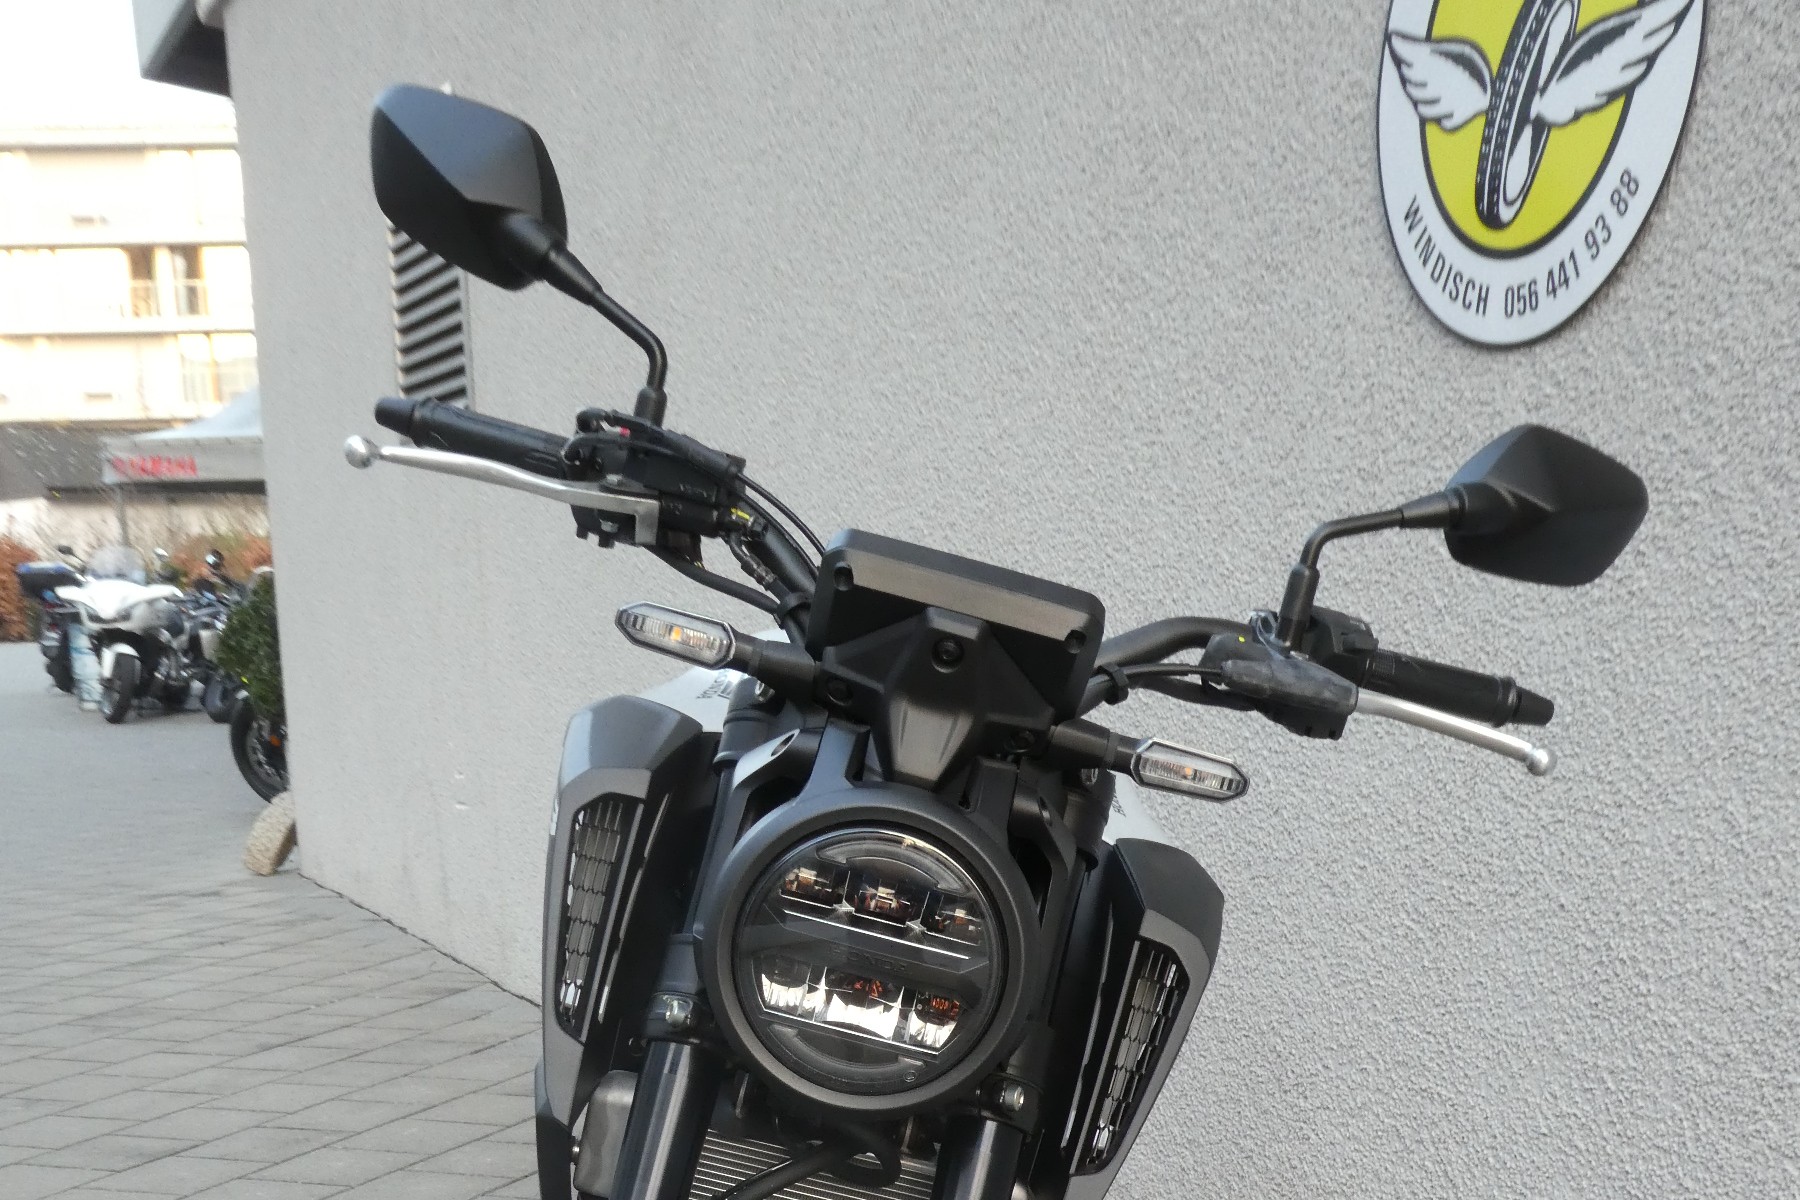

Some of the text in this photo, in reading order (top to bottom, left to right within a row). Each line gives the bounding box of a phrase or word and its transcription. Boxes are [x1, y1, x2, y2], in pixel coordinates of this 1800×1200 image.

[1403, 167, 1640, 319] WINDISCH 056 441 93 88
